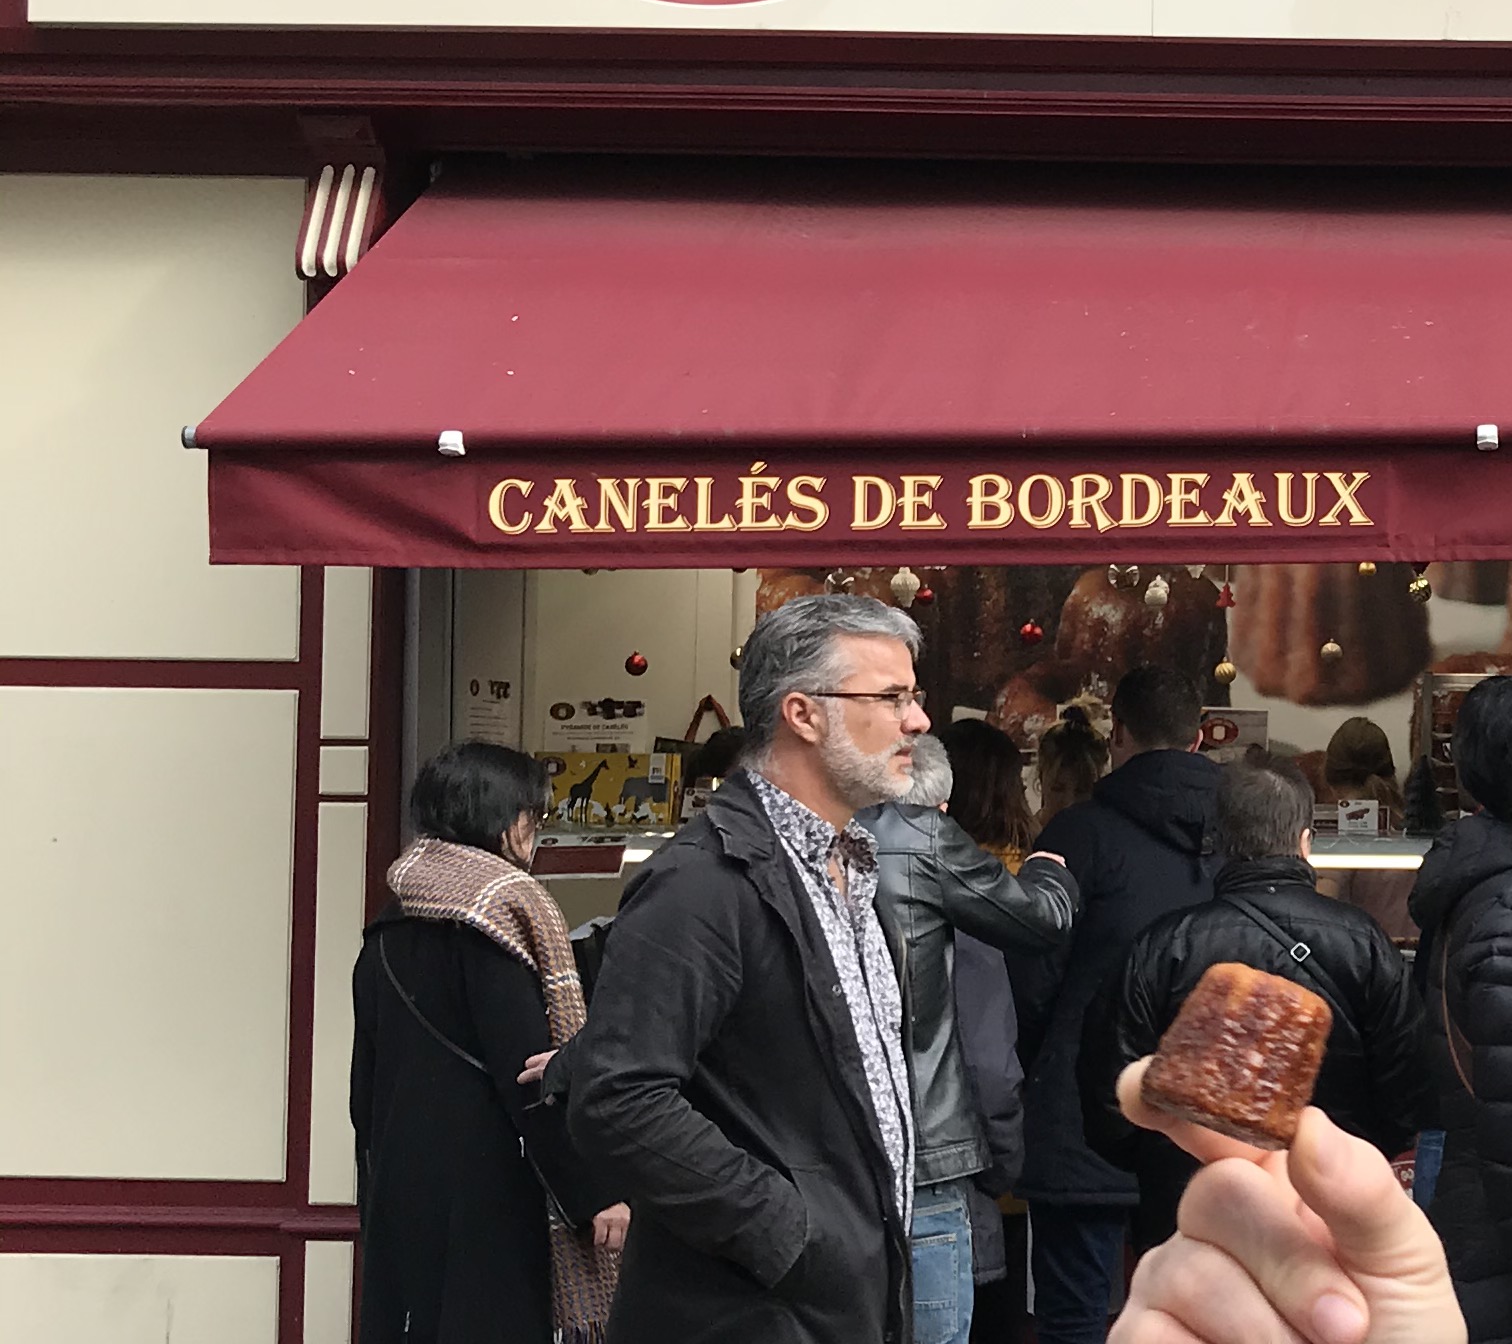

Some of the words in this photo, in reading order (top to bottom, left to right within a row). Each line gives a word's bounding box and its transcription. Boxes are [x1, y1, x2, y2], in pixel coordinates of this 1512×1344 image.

[487, 460, 830, 534] CANELÉS
[849, 474, 949, 532] DE
[965, 470, 1377, 533] BORDEAUX
